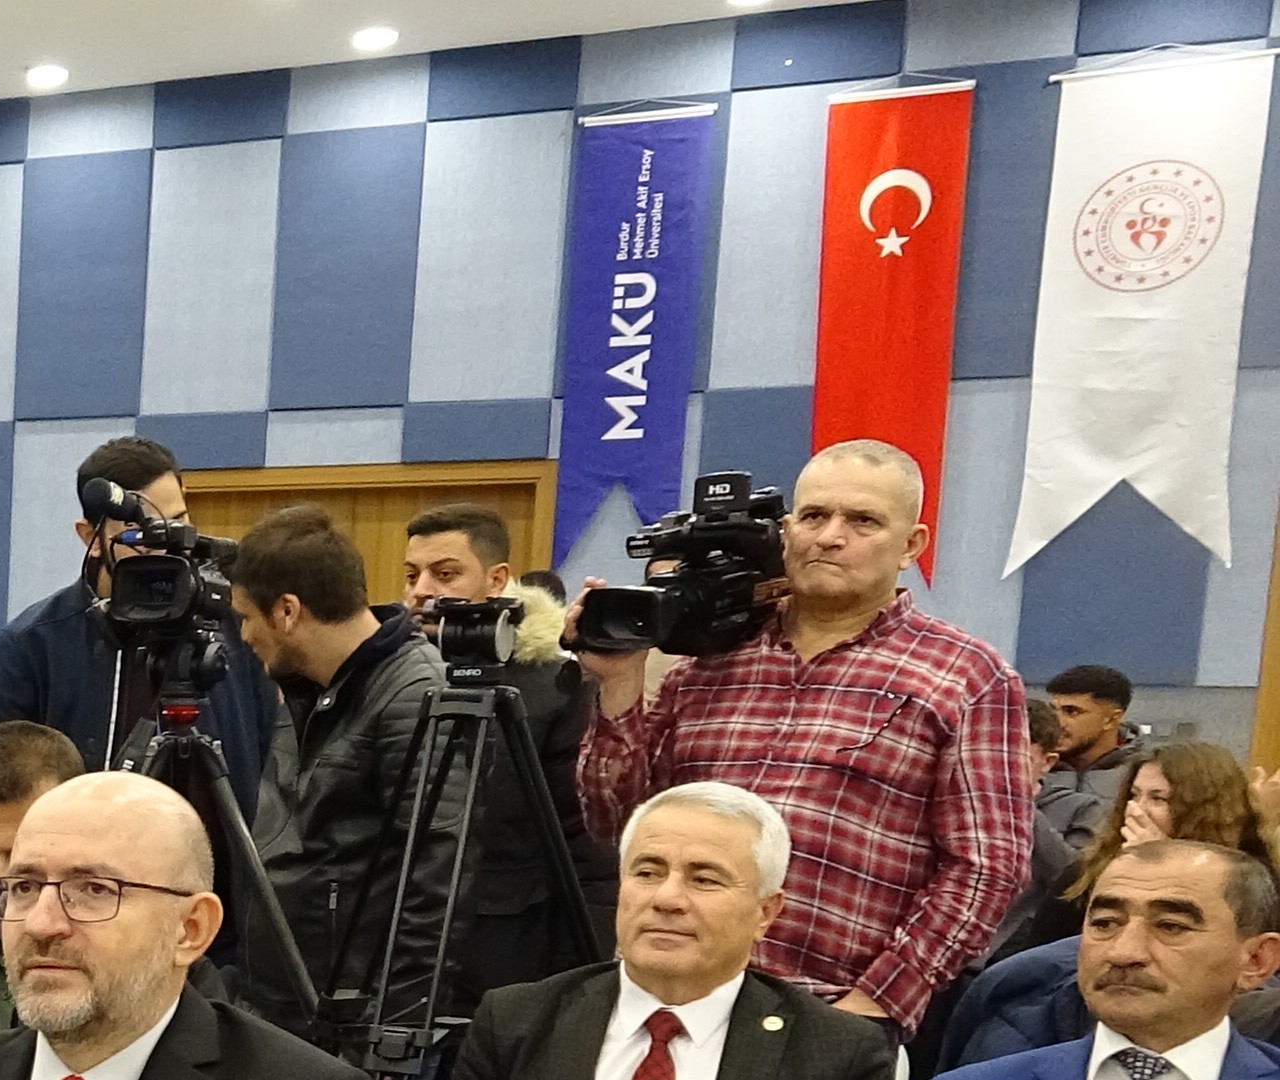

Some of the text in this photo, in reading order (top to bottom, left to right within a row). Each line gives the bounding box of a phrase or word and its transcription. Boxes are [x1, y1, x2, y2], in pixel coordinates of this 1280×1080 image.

[615, 221, 631, 260] Burdur
[632, 148, 655, 259] Mehmet Akif Ersoy
[600, 272, 657, 441] MAKÜ
[708, 483, 731, 495] HD
